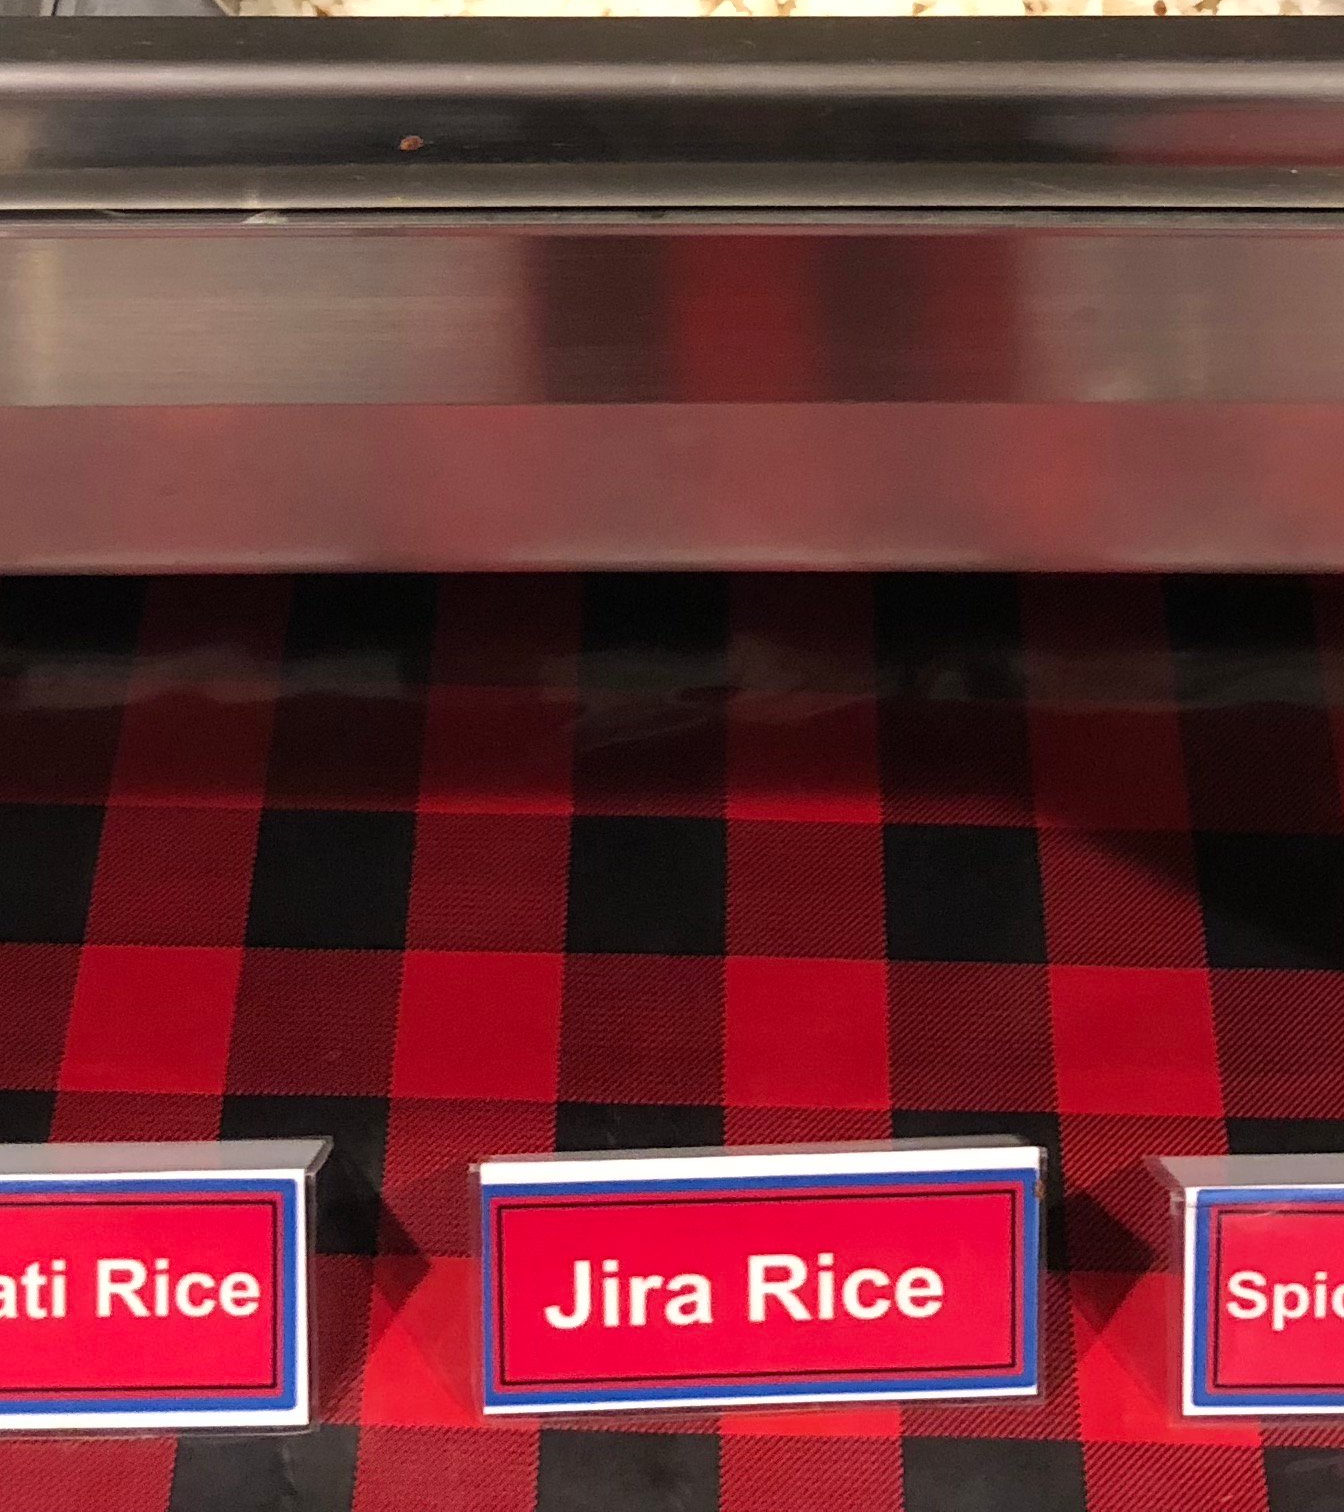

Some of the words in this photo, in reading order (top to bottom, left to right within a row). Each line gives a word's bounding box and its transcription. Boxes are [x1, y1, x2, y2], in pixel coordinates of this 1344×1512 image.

[96, 1258, 261, 1318] Rice
[544, 1259, 715, 1330] Jira
[748, 1252, 944, 1323] Rice
